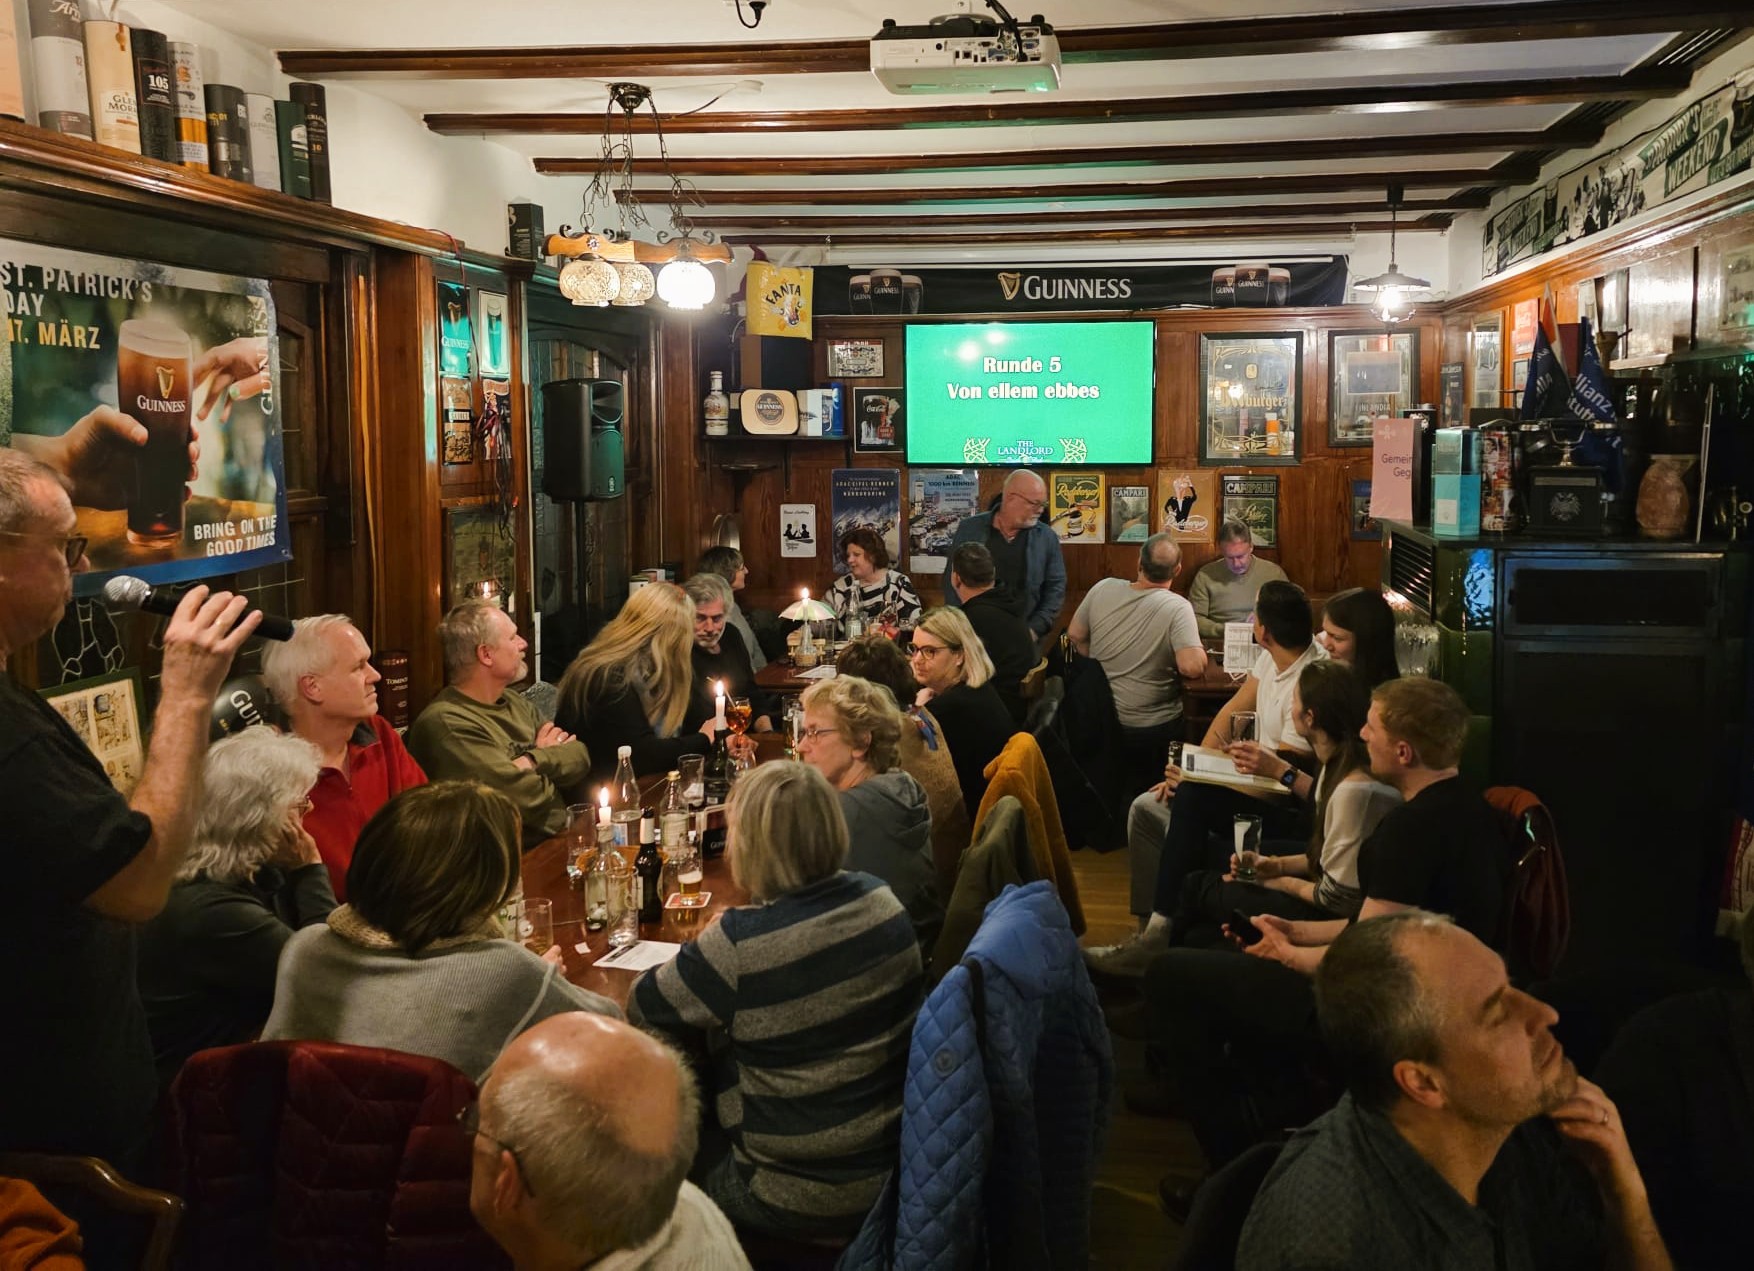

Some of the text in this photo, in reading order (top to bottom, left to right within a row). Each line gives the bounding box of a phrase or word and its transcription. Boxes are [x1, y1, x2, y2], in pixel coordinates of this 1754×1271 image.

[148, 75, 168, 89] 105
[0, 261, 153, 303] ST. PATRICK'S
[1024, 275, 1132, 300] GUINNESS
[6, 290, 44, 317] DAY
[766, 282, 802, 305] FANTA
[38, 318, 101, 350] MÄRZ
[983, 355, 1062, 373] Runde 5
[947, 382, 1101, 400] Von ellem ebbes
[1575, 373, 1613, 414] llianz
[137, 394, 186, 413] GUINNESS
[998, 447, 1054, 456] LANDLORD
[1016, 440, 1034, 448] THE
[1113, 489, 1146, 497] CAMPARI
[1226, 482, 1274, 494] CAMPARI
[194, 514, 278, 540] BRING ON THE
[206, 531, 276, 557] GOOD TIMES
